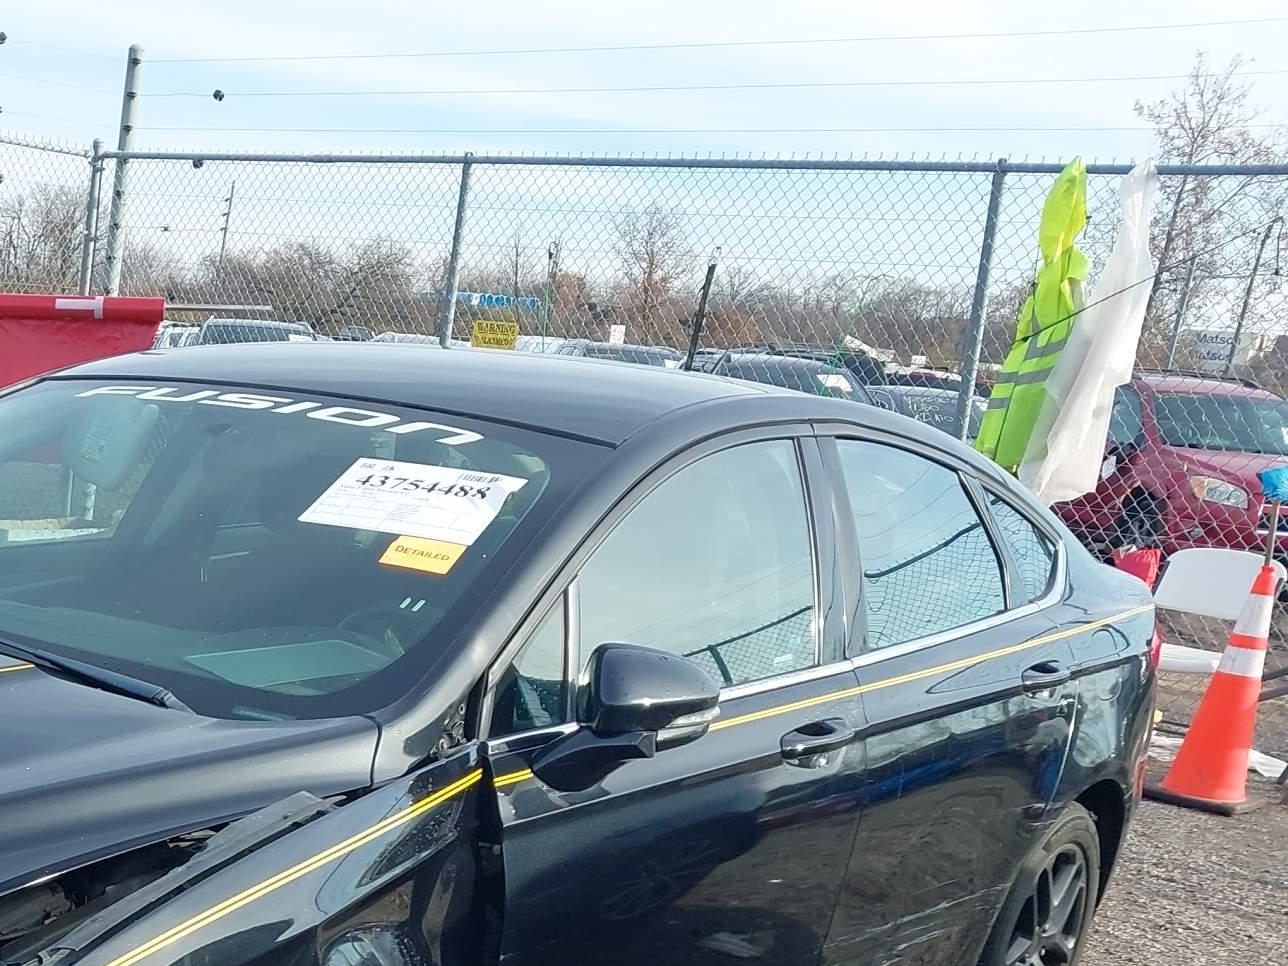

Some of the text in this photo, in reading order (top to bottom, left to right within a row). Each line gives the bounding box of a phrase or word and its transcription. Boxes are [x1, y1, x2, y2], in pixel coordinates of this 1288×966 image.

[477, 322, 516, 334] WARNING
[74, 385, 485, 446] FUSION
[355, 473, 492, 501] 43754488
[394, 544, 450, 562] DETAILED
